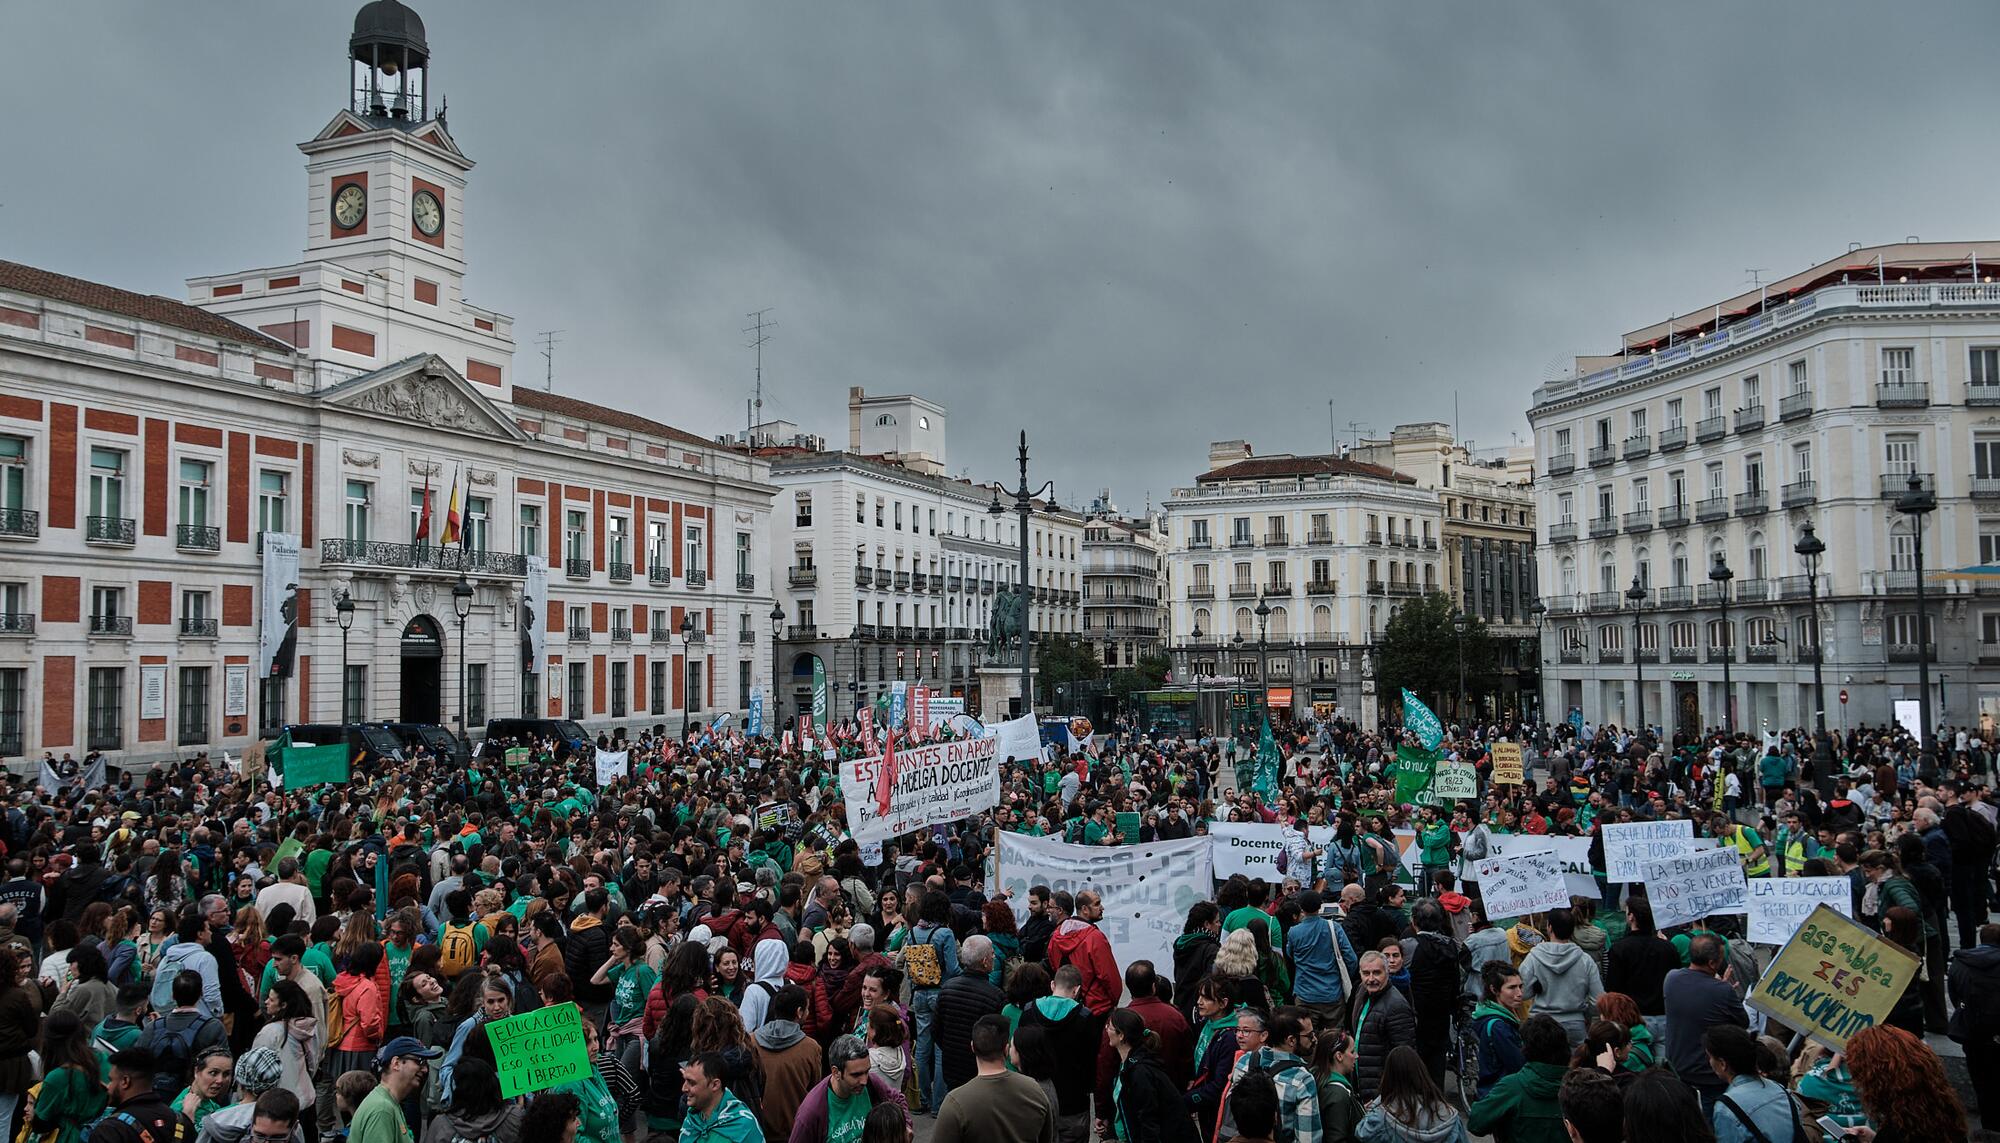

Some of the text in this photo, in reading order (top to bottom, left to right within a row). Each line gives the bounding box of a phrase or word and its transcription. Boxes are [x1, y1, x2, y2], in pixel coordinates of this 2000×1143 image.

[272, 545, 298, 554] Palacios
[751, 702, 761, 734] ANPE
[914, 688, 924, 726] CCOO
[801, 716, 810, 741] UG
[862, 710, 873, 752] CCOO
[854, 738, 995, 782] ESTIANTES EN APOYO
[867, 782, 878, 803] A
[901, 766, 938, 795] HUELGA
[941, 757, 992, 785] DOCENTE
[1436, 785, 1460, 793] LECTIVAS
[860, 807, 870, 822] Por
[928, 786, 949, 804] calidad
[893, 821, 907, 834] CRT
[1607, 825, 1652, 842] ESCUELA
[1231, 837, 1283, 850] Docente
[1624, 843, 1639, 858] DE
[1245, 855, 1267, 865] por
[1615, 860, 1638, 877] PARA
[1650, 850, 1737, 881] LA EDUCACIÓN
[1683, 878, 1698, 894] SE
[1701, 870, 1742, 890] VENDE,
[1755, 879, 1849, 897] LA EDUCACIÓN
[1666, 887, 1745, 919] SE DEFIENDE
[1760, 902, 1812, 918] PÚBLICA
[1756, 921, 1776, 936] SE
[1801, 924, 1893, 989] asamblea
[494, 1008, 575, 1041] EDUCACIÓN
[500, 1031, 580, 1057] DE CALIDAD:
[501, 1059, 523, 1072] ESO
[542, 1053, 555, 1063] ES
[513, 1062, 576, 1090] LIBERTAD
